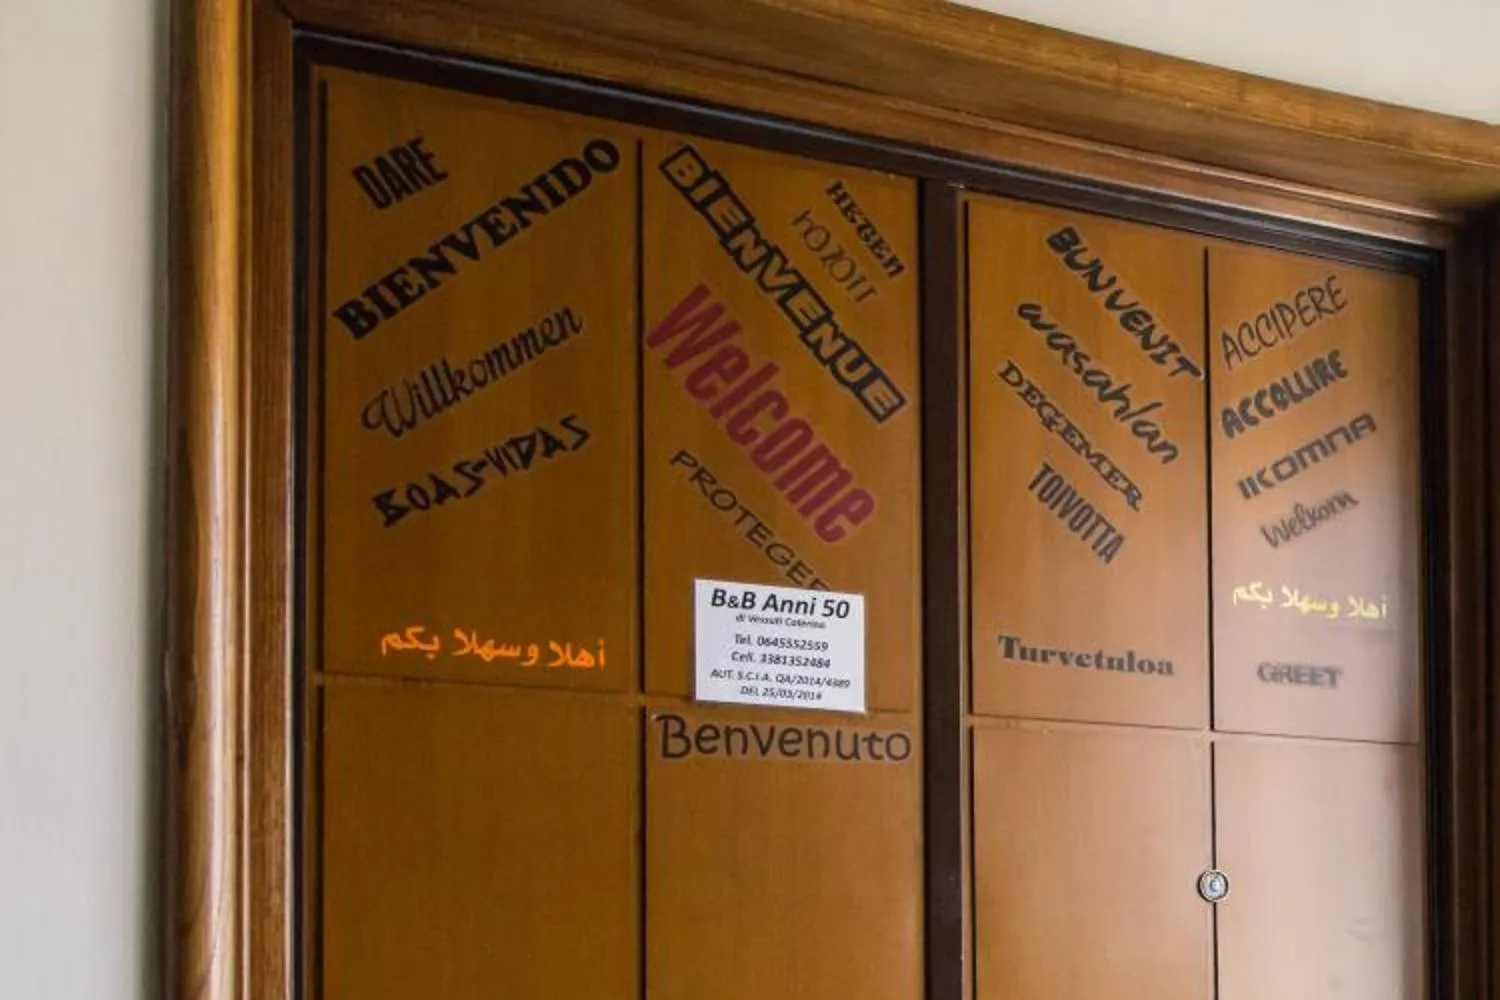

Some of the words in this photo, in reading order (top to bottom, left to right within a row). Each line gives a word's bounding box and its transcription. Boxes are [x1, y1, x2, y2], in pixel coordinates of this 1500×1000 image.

[351, 137, 449, 210] DARE
[332, 139, 621, 341] BIENVENIDO
[658, 144, 908, 424] BIENVENUE
[1221, 275, 1349, 370] ACCIPERE
[361, 306, 585, 438] Willkommen
[646, 283, 877, 543] Welcome
[1221, 349, 1349, 439] ACCOLLIRE
[1028, 461, 1126, 565] TOIVOTTA
[380, 625, 441, 660] بكم
[711, 588, 756, 609] B&B
[762, 593, 817, 616] Anni
[821, 598, 850, 619] 50
[735, 633, 753, 646] Tel.
[1256, 660, 1344, 689] GREET
[652, 713, 912, 762] Benvenuto
